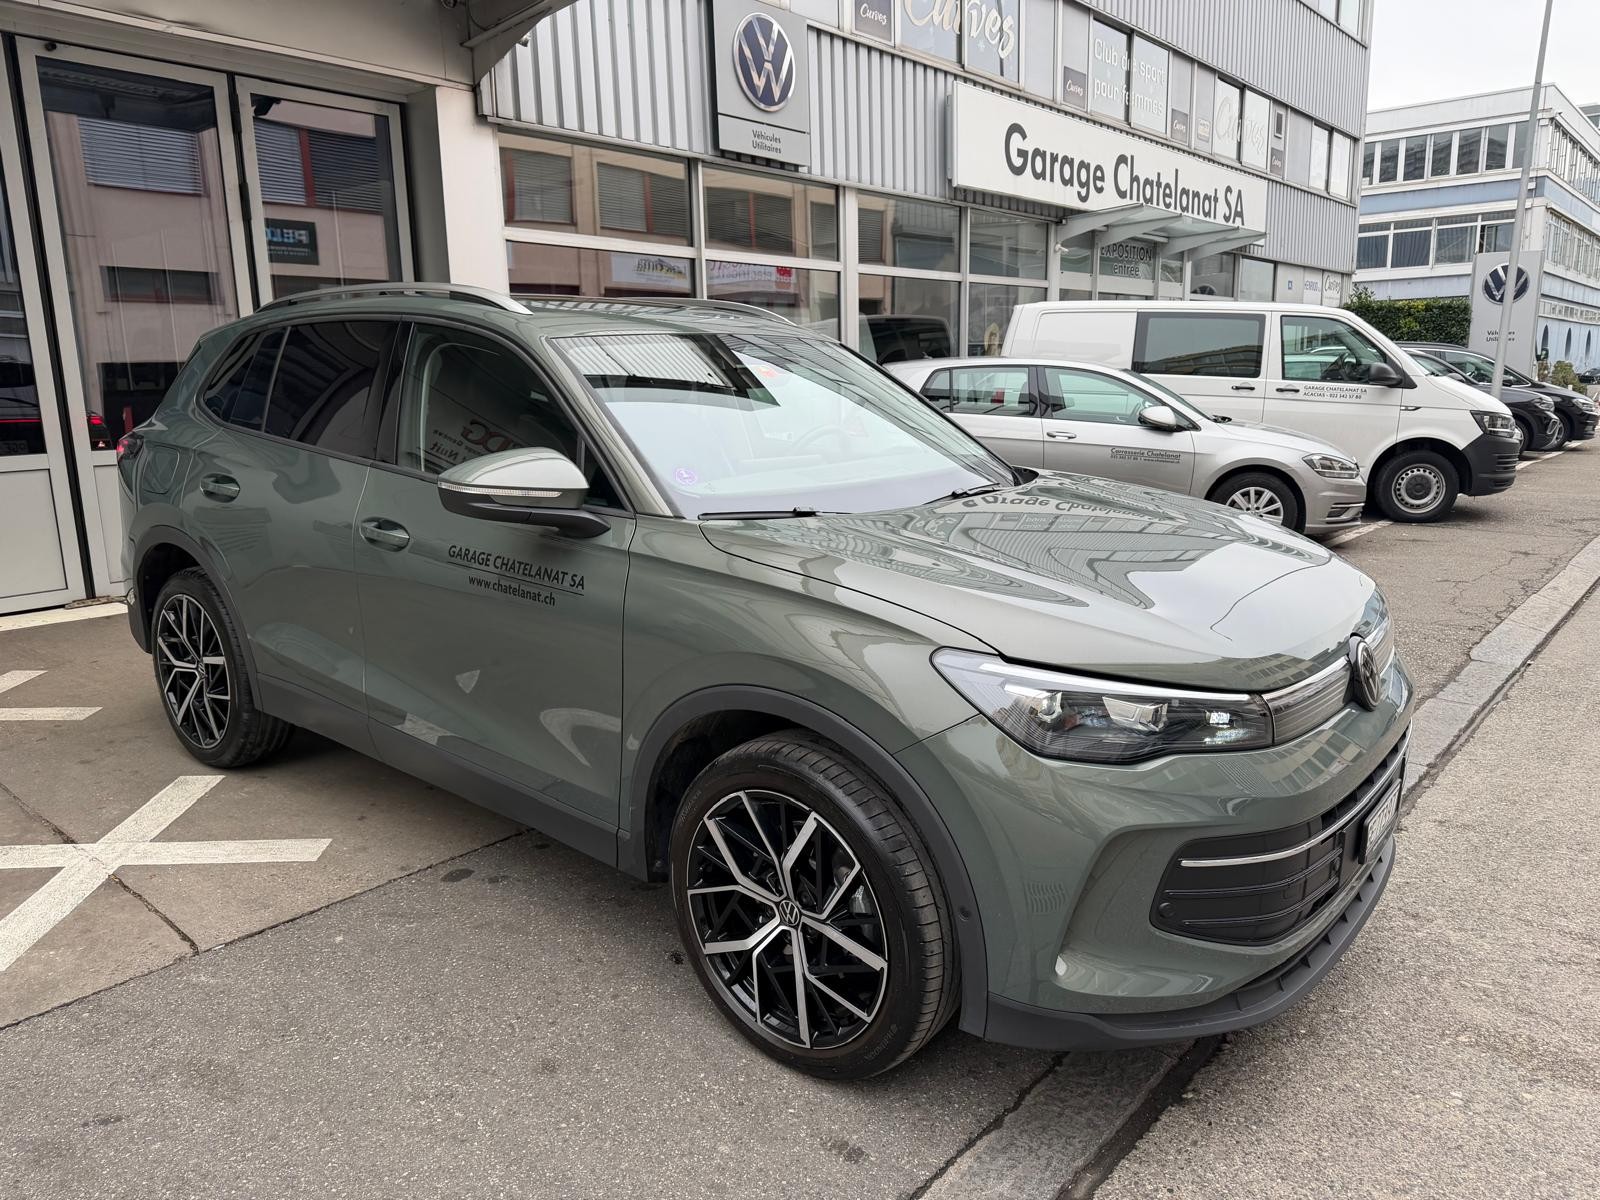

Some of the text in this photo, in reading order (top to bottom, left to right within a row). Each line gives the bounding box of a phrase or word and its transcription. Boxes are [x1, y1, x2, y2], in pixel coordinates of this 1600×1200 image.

[860, 4, 887, 25] Curves
[1094, 38, 1118, 67] Club
[1140, 61, 1165, 86] sport
[1094, 78, 1119, 101] pour
[752, 129, 782, 144] Véhicules
[752, 139, 782, 154] Utilitaires
[1004, 122, 1246, 226] Garage Chatelanat SA
[1100, 243, 1154, 261] EXPOSITION
[448, 545, 585, 590] GARAGE CHATELANAT SA
[468, 575, 556, 606] www.chatelanat.ch
